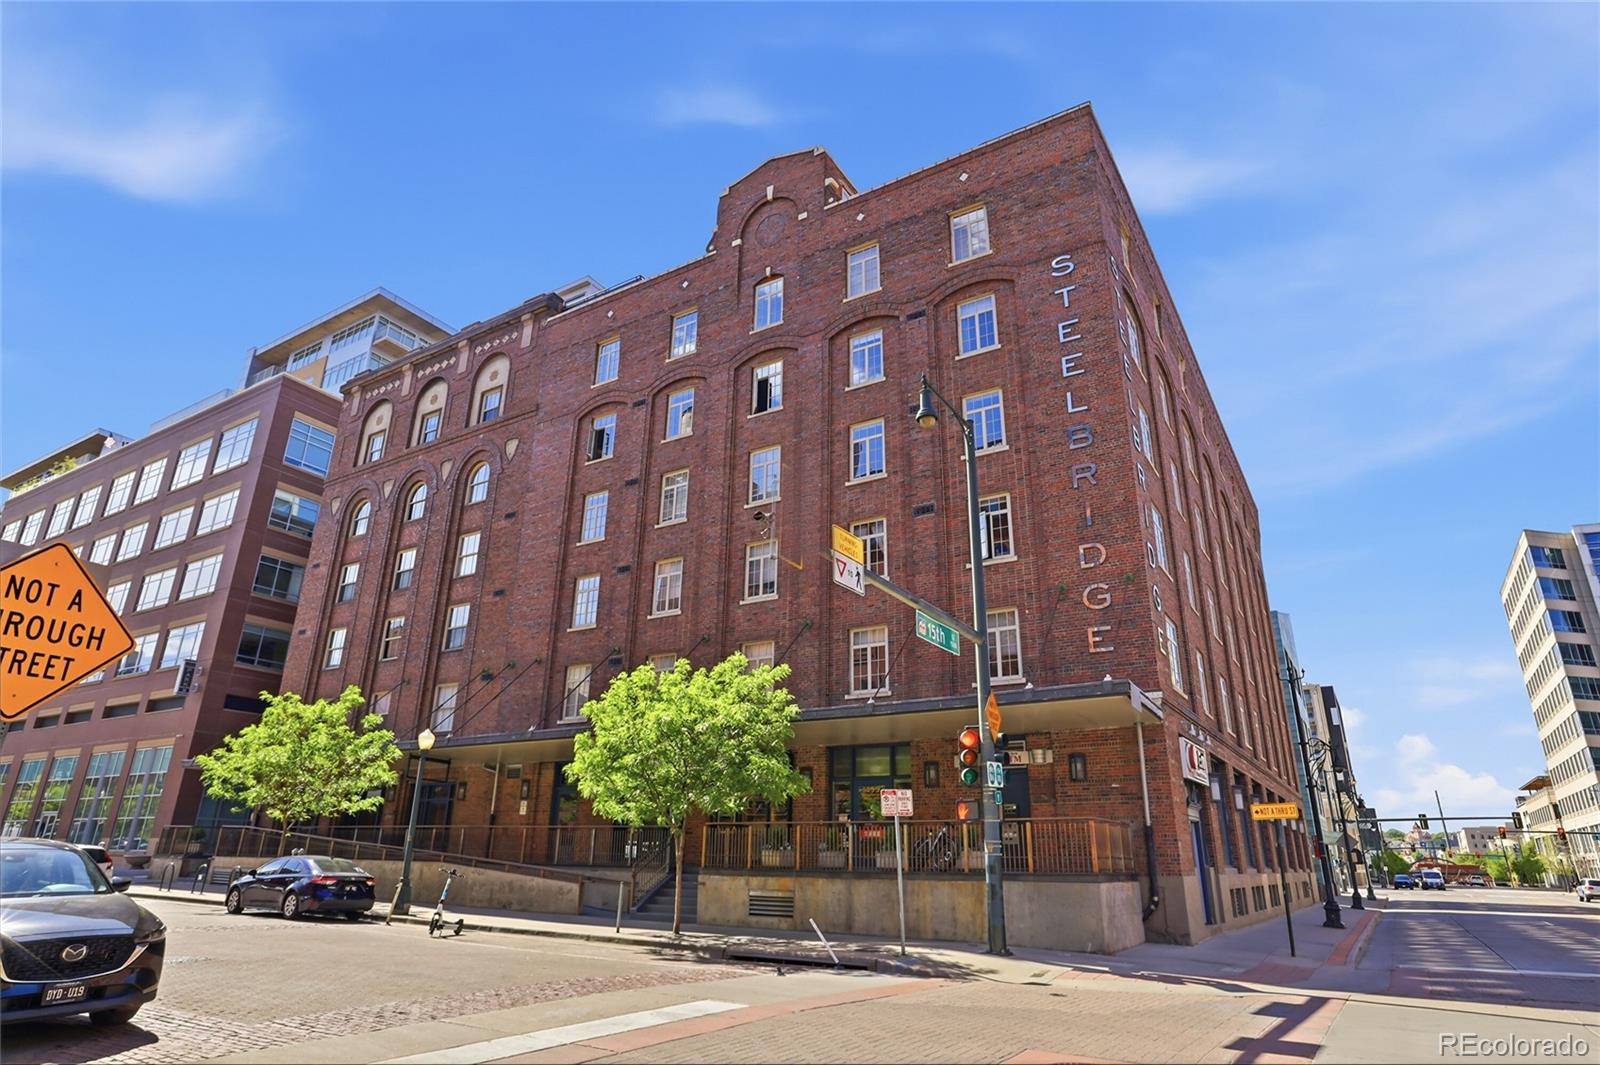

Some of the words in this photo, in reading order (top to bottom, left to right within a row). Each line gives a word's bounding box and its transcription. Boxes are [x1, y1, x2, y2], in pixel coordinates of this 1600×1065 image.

[1051, 254, 1114, 654] STEELBRIDGE
[1110, 255, 1167, 655] STEELBRIDGE
[5, 574, 60, 606] NOT
[67, 589, 82, 612] A
[0, 609, 106, 651] ROUGH
[927, 622, 946, 645] 15th
[1260, 807, 1269, 815] NOT
